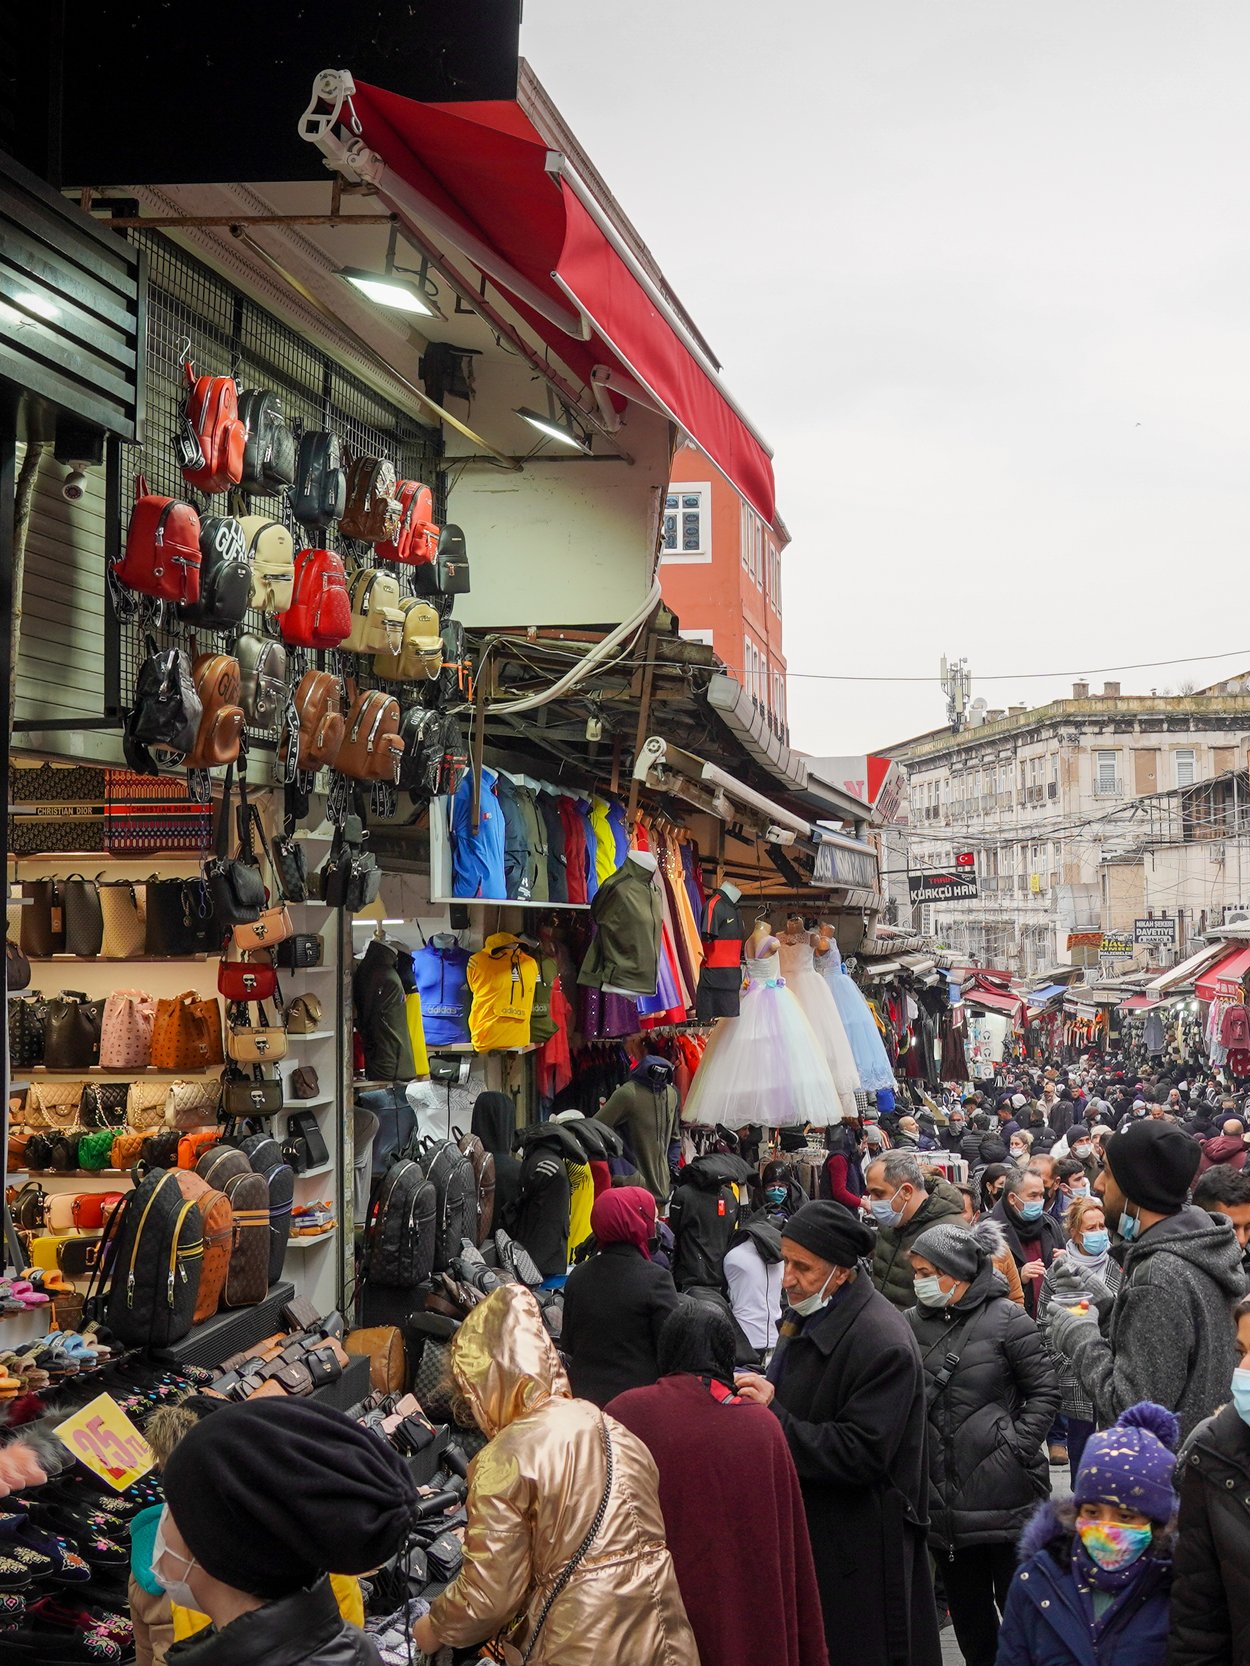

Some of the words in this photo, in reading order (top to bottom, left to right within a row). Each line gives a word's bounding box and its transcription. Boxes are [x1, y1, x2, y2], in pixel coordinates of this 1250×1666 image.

[37, 807, 75, 816] CHRISTIAN
[76, 806, 93, 815] DIOR
[954, 885, 977, 897] HAN
[427, 1005, 458, 1014] adidas
[501, 1007, 526, 1016] adidas
